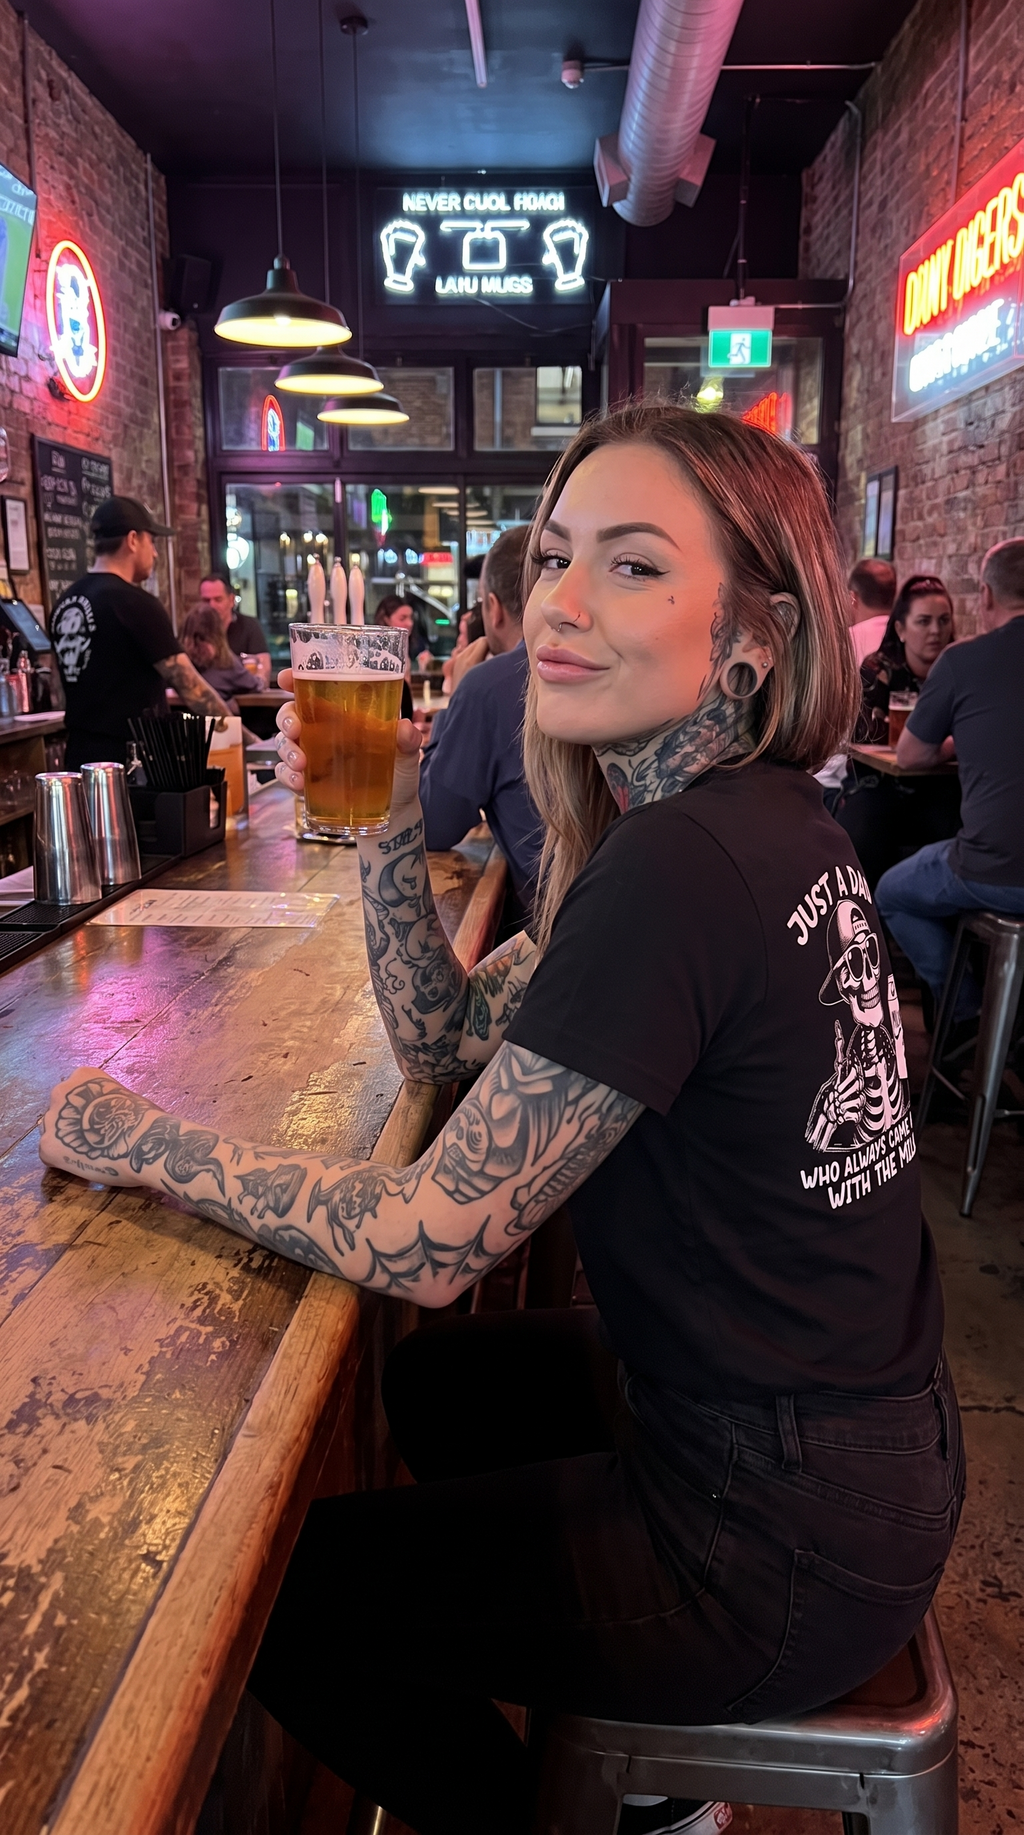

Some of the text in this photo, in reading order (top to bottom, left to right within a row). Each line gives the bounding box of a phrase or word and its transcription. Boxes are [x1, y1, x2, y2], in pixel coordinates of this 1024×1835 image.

[402, 191, 461, 212] NEVER
[481, 274, 533, 294] MUGS
[787, 871, 833, 946] JUST
[835, 866, 848, 897] A
[800, 1161, 840, 1189] WHO
[844, 1135, 886, 1177] ALWAYS
[888, 1116, 910, 1148] CAME
[827, 1170, 871, 1209] WITH
[874, 1151, 897, 1186] THE
